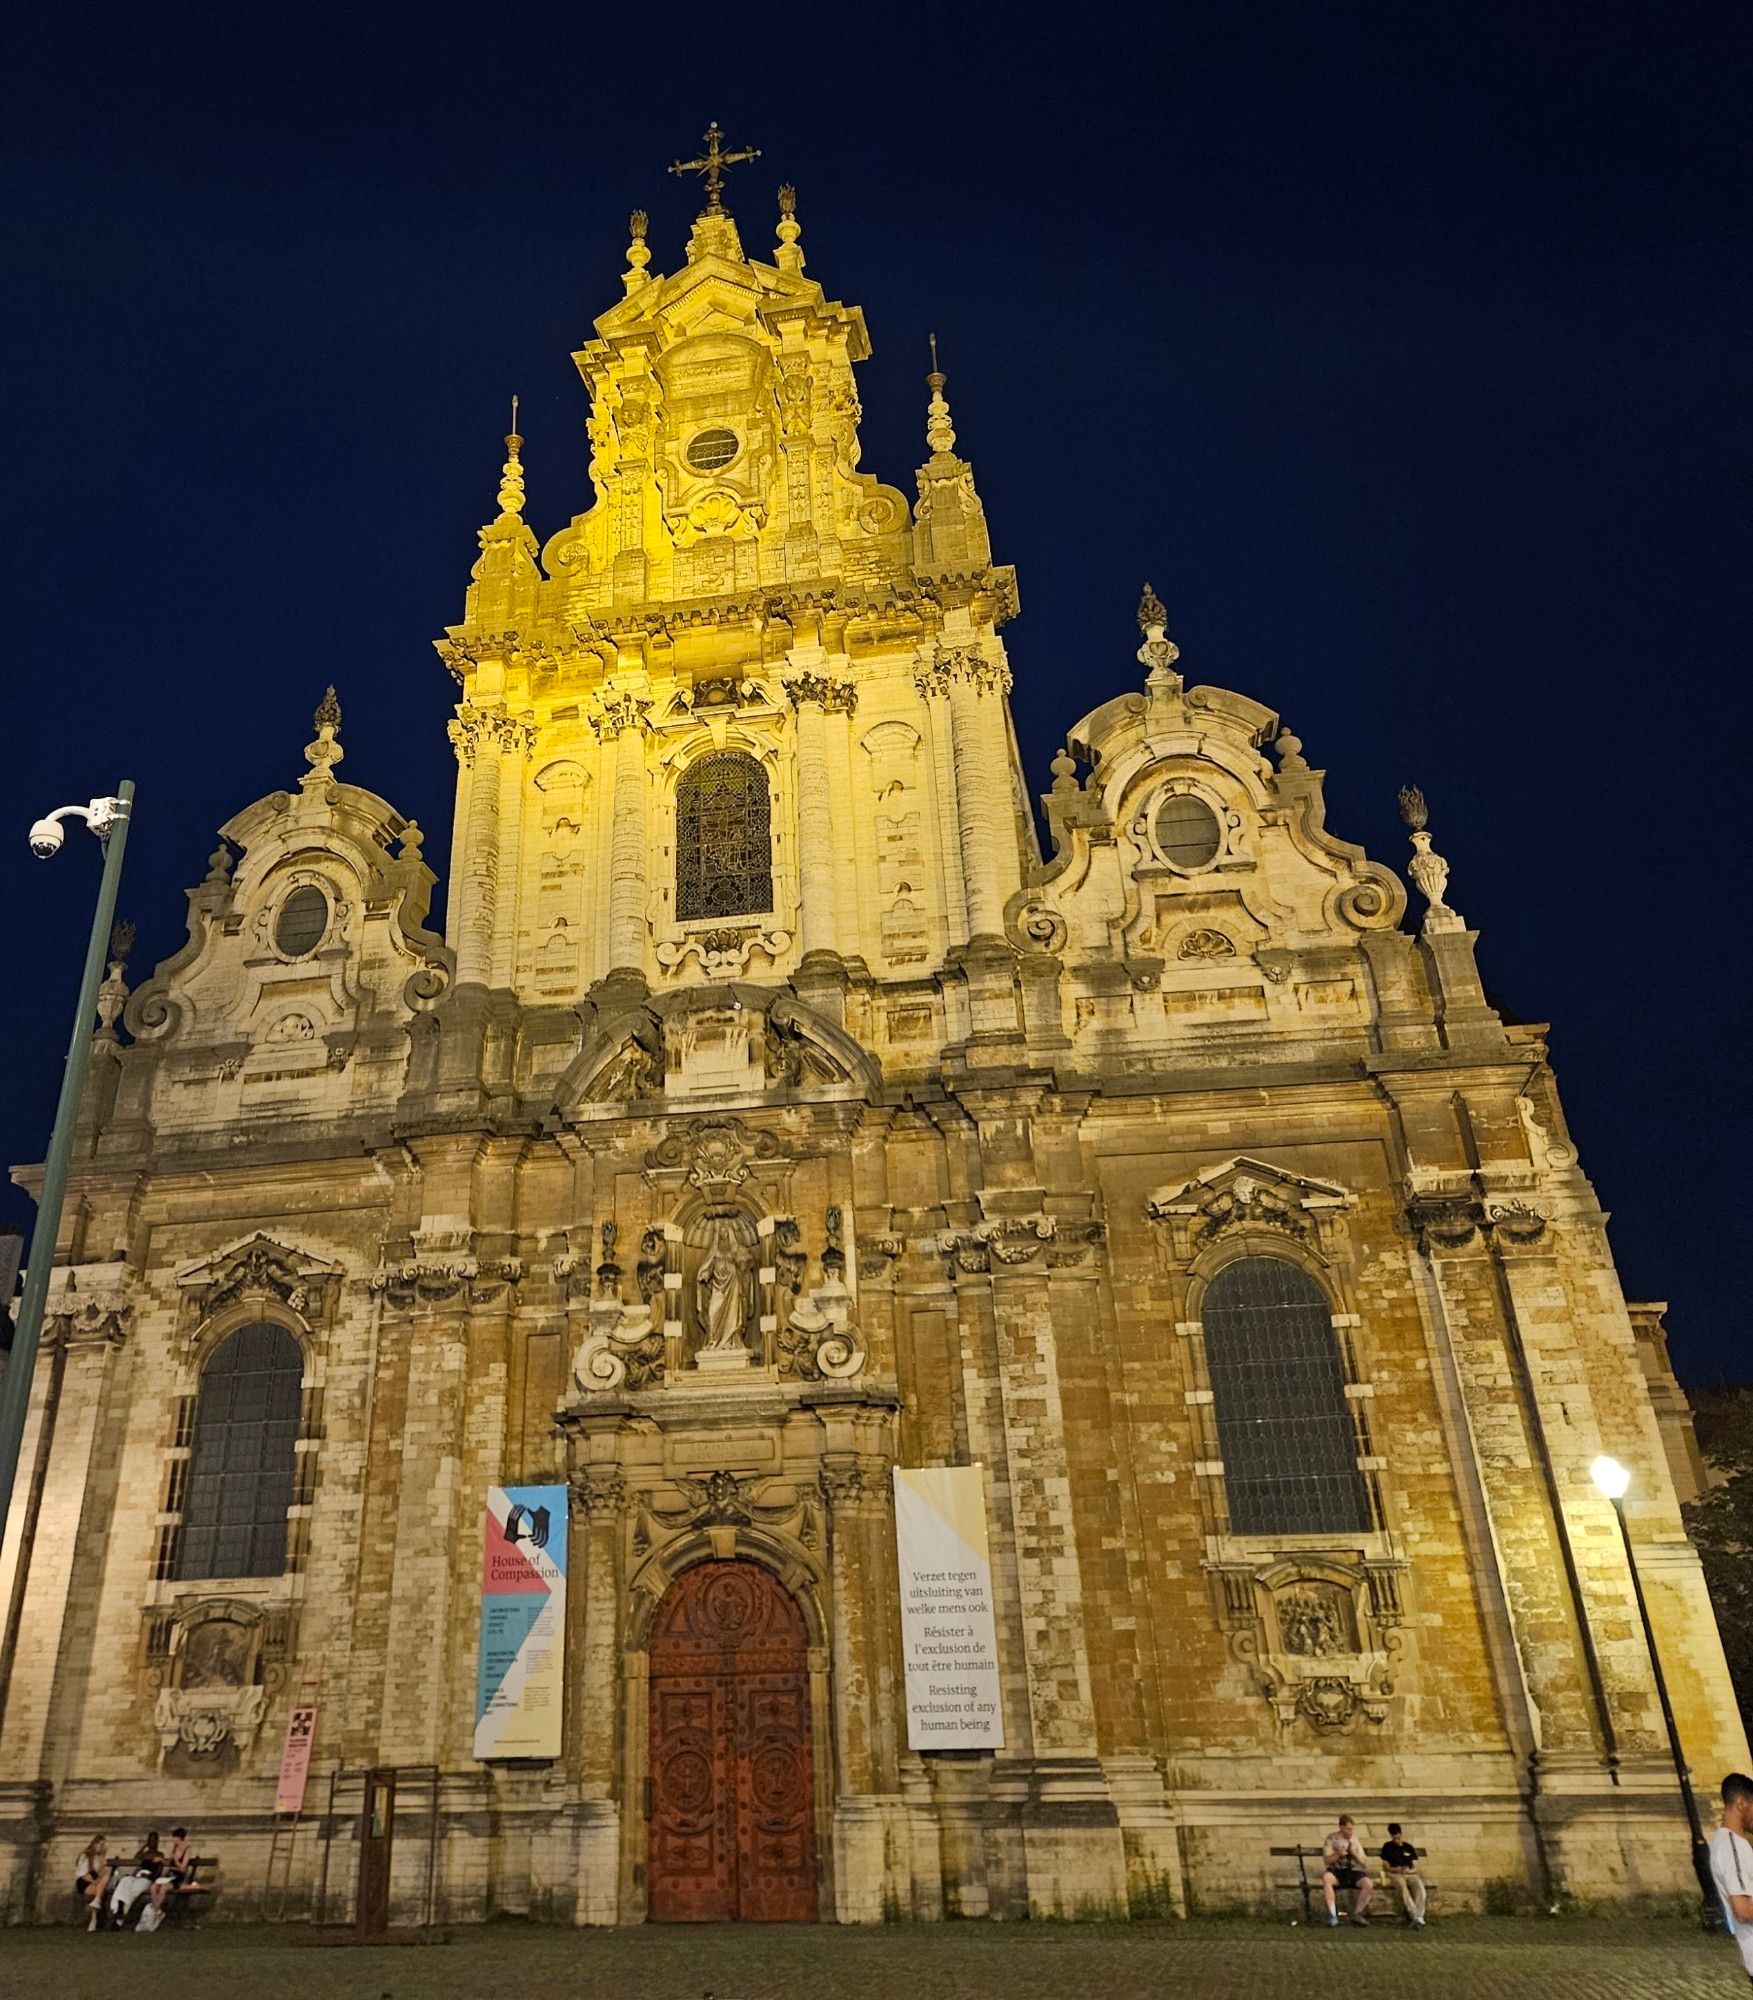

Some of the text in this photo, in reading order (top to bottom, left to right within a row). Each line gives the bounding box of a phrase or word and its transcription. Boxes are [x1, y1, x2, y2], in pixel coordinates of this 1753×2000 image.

[492, 1554, 540, 1567] House of
[491, 1567, 559, 1582] Compassion
[913, 1571, 977, 1583] Verzet tegen
[909, 1586, 983, 1599] uitsluiting van
[906, 1601, 989, 1614] welke mens ook
[924, 1624, 974, 1637] Résister à
[972, 1641, 986, 1653] de
[908, 1659, 995, 1671] tout être humain
[928, 1684, 977, 1698] Resisting
[912, 1700, 997, 1715] exclusion of any
[920, 1719, 990, 1732] human being
